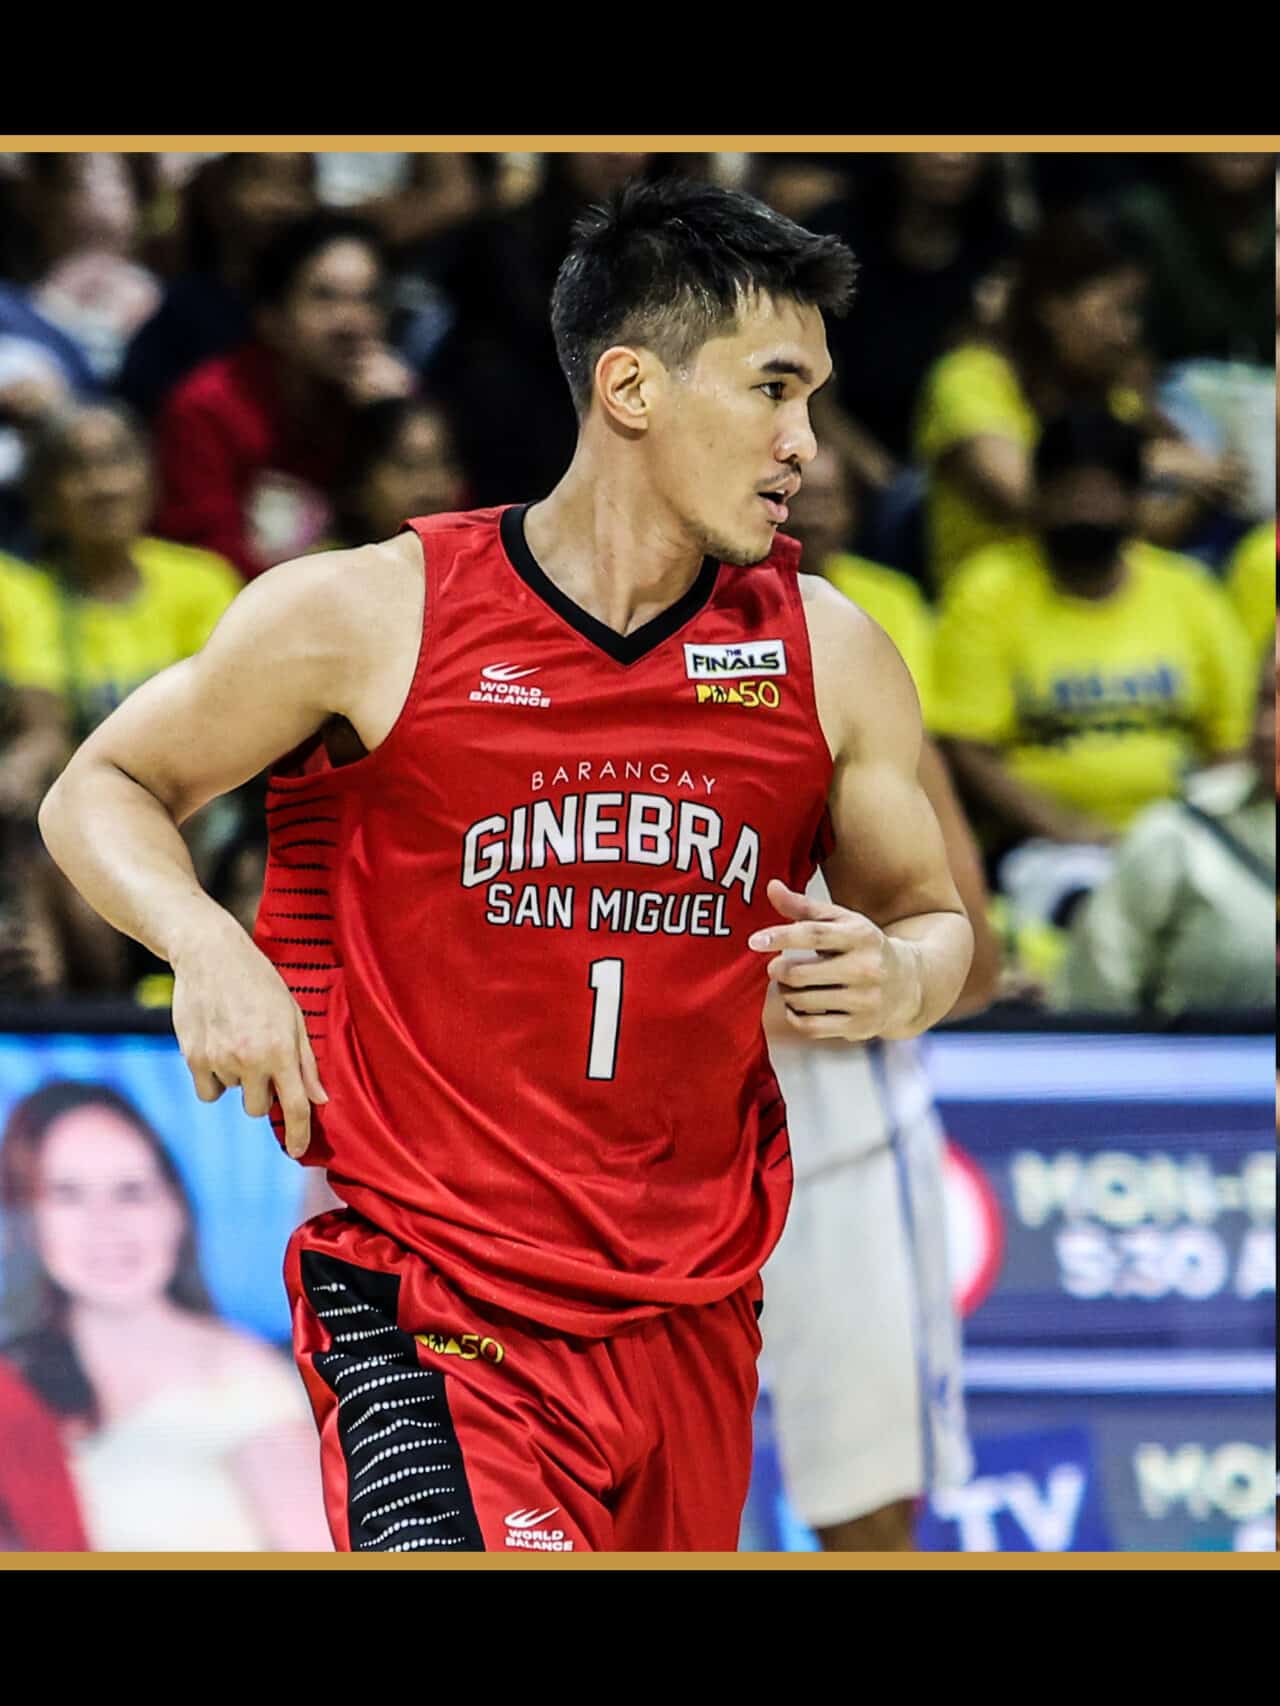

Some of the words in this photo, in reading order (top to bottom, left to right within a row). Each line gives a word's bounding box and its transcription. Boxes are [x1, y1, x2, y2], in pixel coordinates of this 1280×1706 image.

[692, 651, 779, 672] FINALS
[725, 648, 742, 656] THE
[469, 691, 551, 708] BALANCE
[480, 681, 542, 697] WORLD
[532, 761, 717, 795] BARANGAY
[461, 791, 761, 904] GINEBRA
[485, 882, 575, 930] SAN
[588, 888, 732, 937] MIGUEL
[586, 957, 624, 1081] 1
[1132, 1440, 1276, 1521] MO
[930, 1463, 1084, 1551] TV
[505, 1536, 574, 1552] BALANCE
[508, 1529, 564, 1541] WORLD
